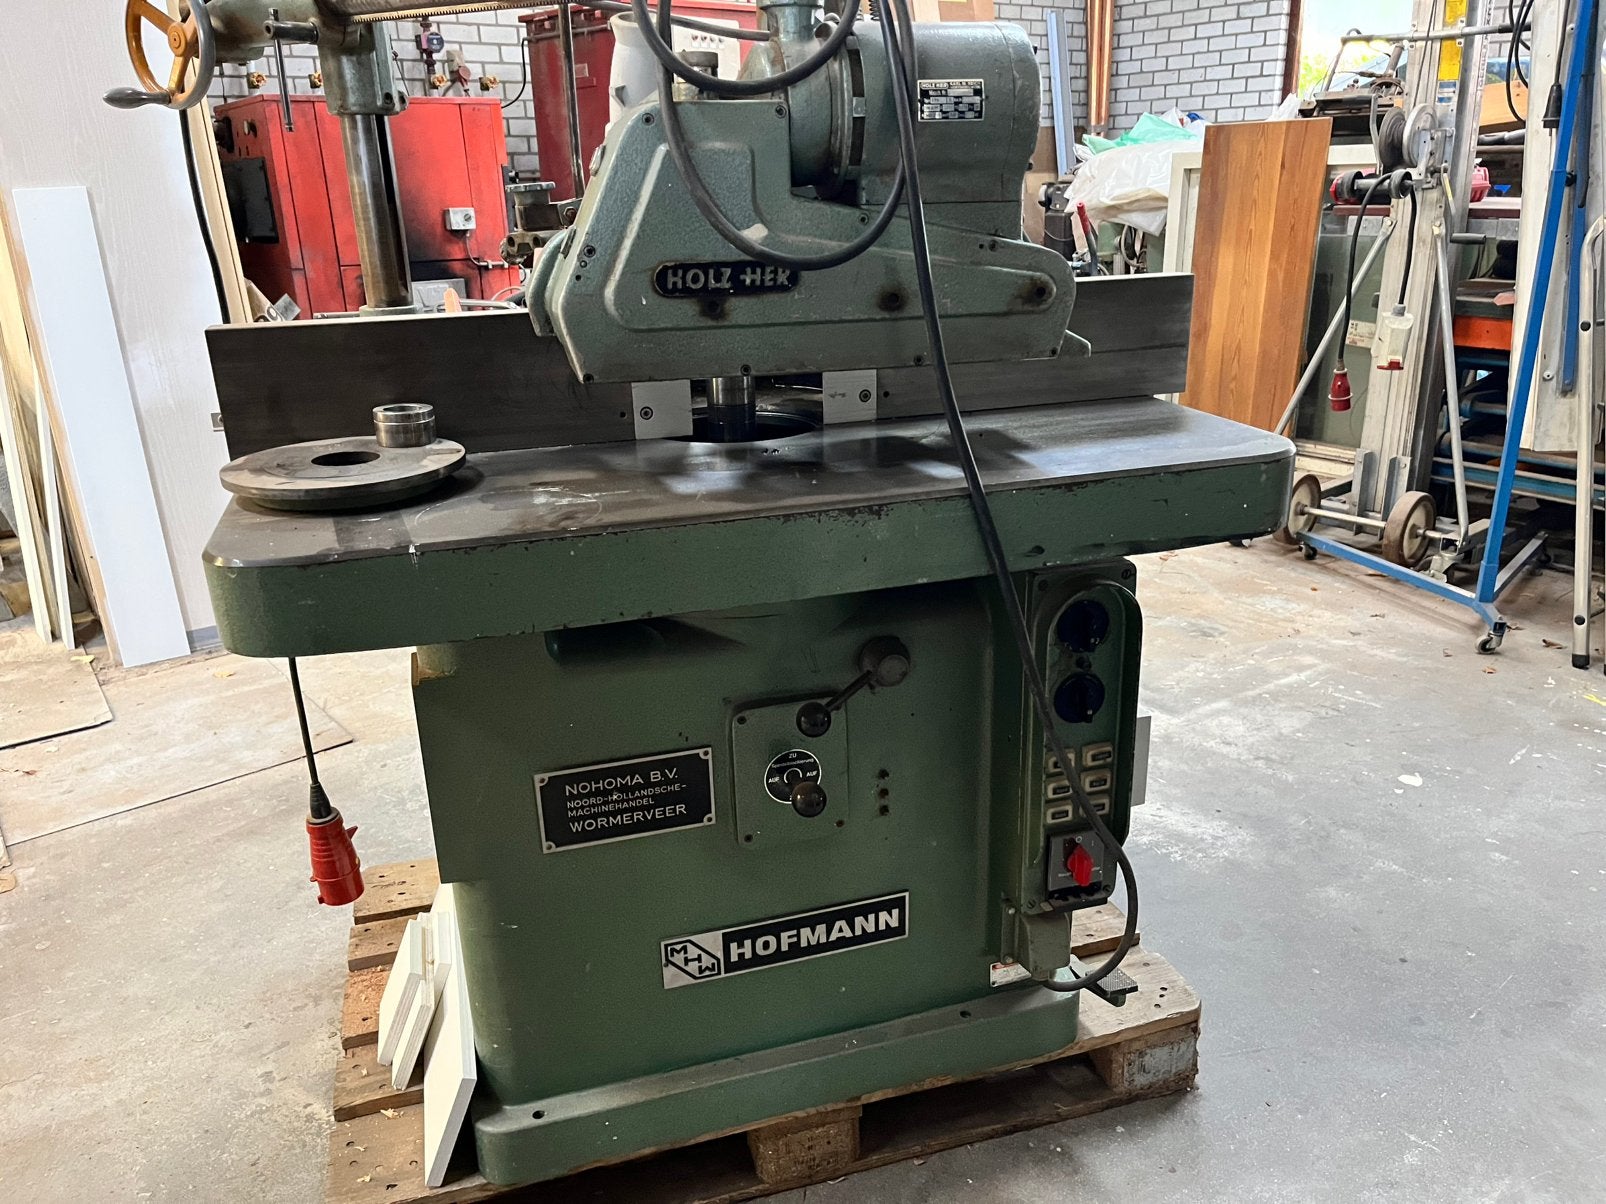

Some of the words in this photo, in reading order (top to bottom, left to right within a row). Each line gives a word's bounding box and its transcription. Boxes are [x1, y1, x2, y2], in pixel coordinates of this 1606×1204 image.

[565, 774, 644, 796] NOHOMA
[650, 768, 678, 782] B.V.
[568, 797, 655, 818] MACHINEHANDEL
[569, 804, 687, 833] WORMERVEER
[730, 908, 899, 962] HOFMANN
